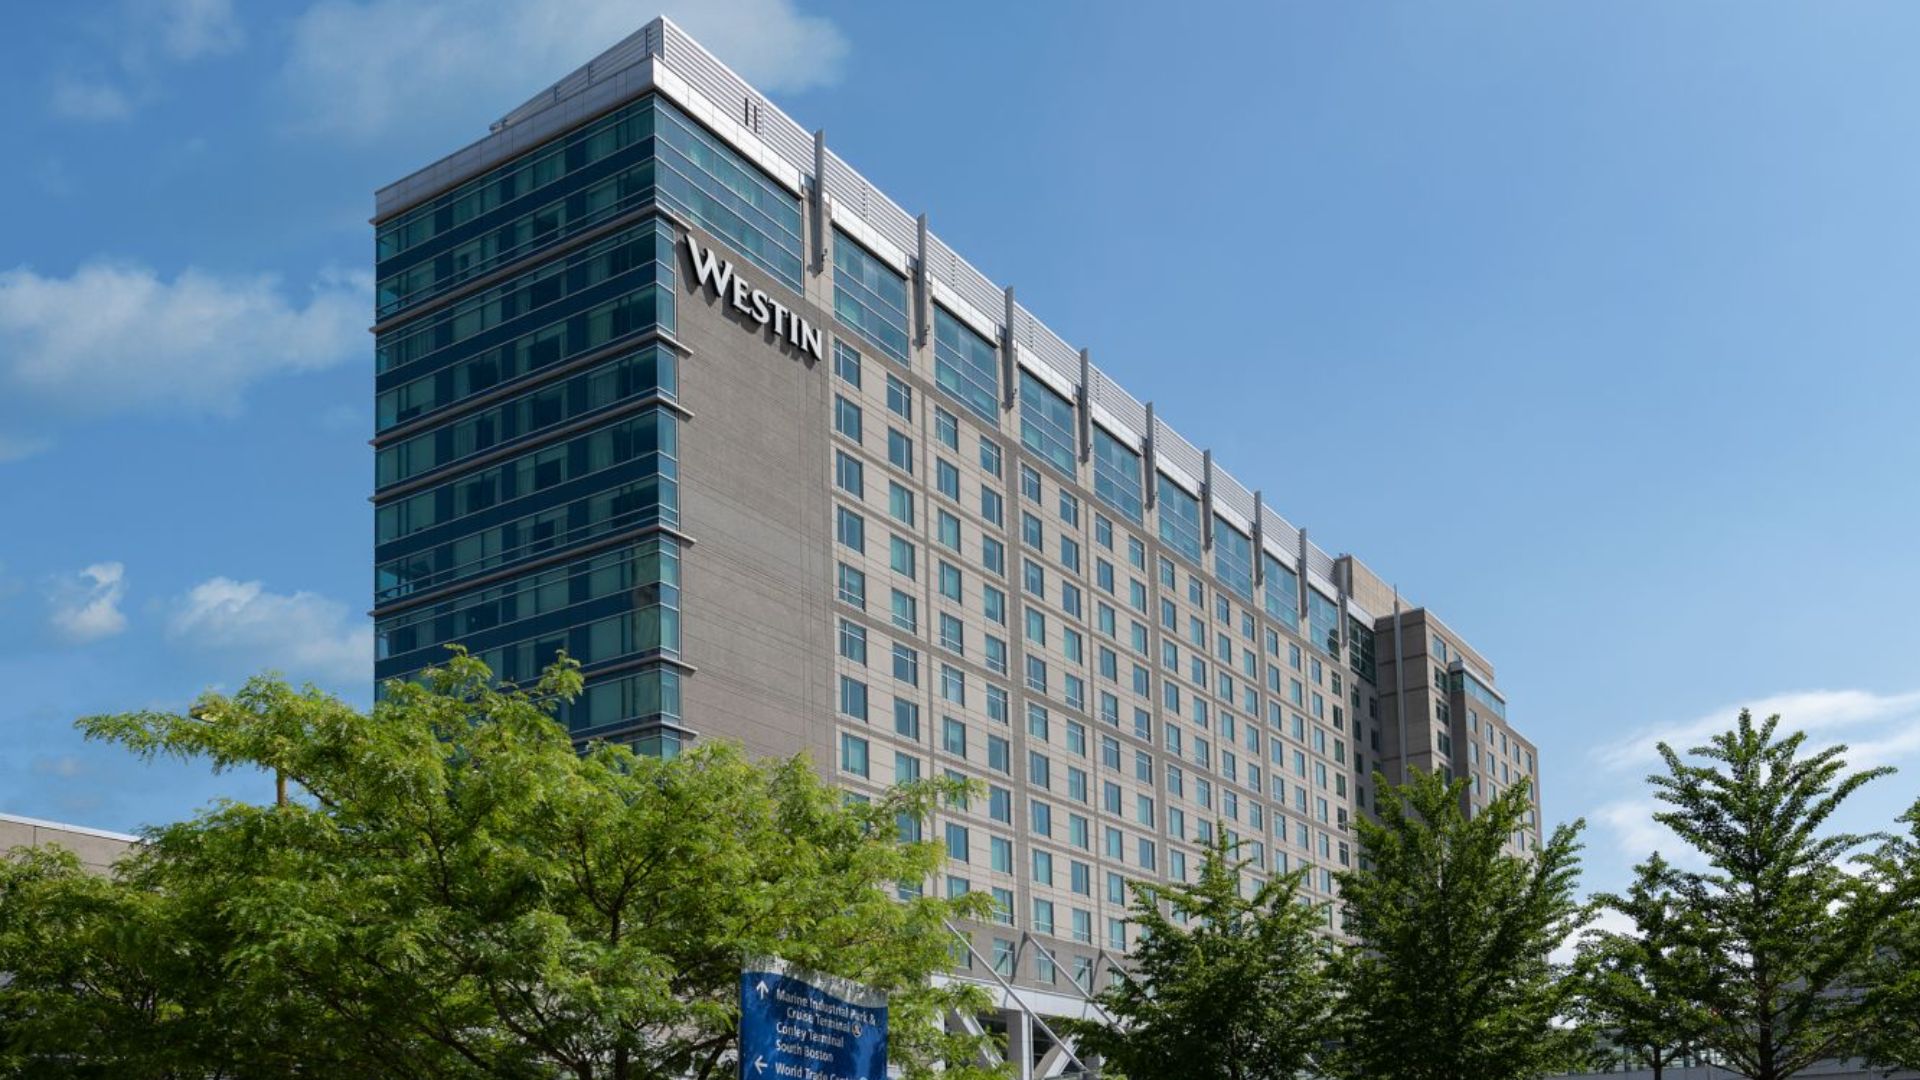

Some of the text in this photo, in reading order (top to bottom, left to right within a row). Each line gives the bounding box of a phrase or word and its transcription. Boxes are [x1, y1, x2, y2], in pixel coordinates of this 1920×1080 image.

[685, 234, 823, 361] WESTIN
[776, 988, 876, 1027] Marine Industrial Park &
[786, 1007, 850, 1032] Cruise Terminal
[776, 1022, 844, 1048] Conley Terminal
[776, 1039, 834, 1062] South Boston
[775, 1062, 803, 1078] World
